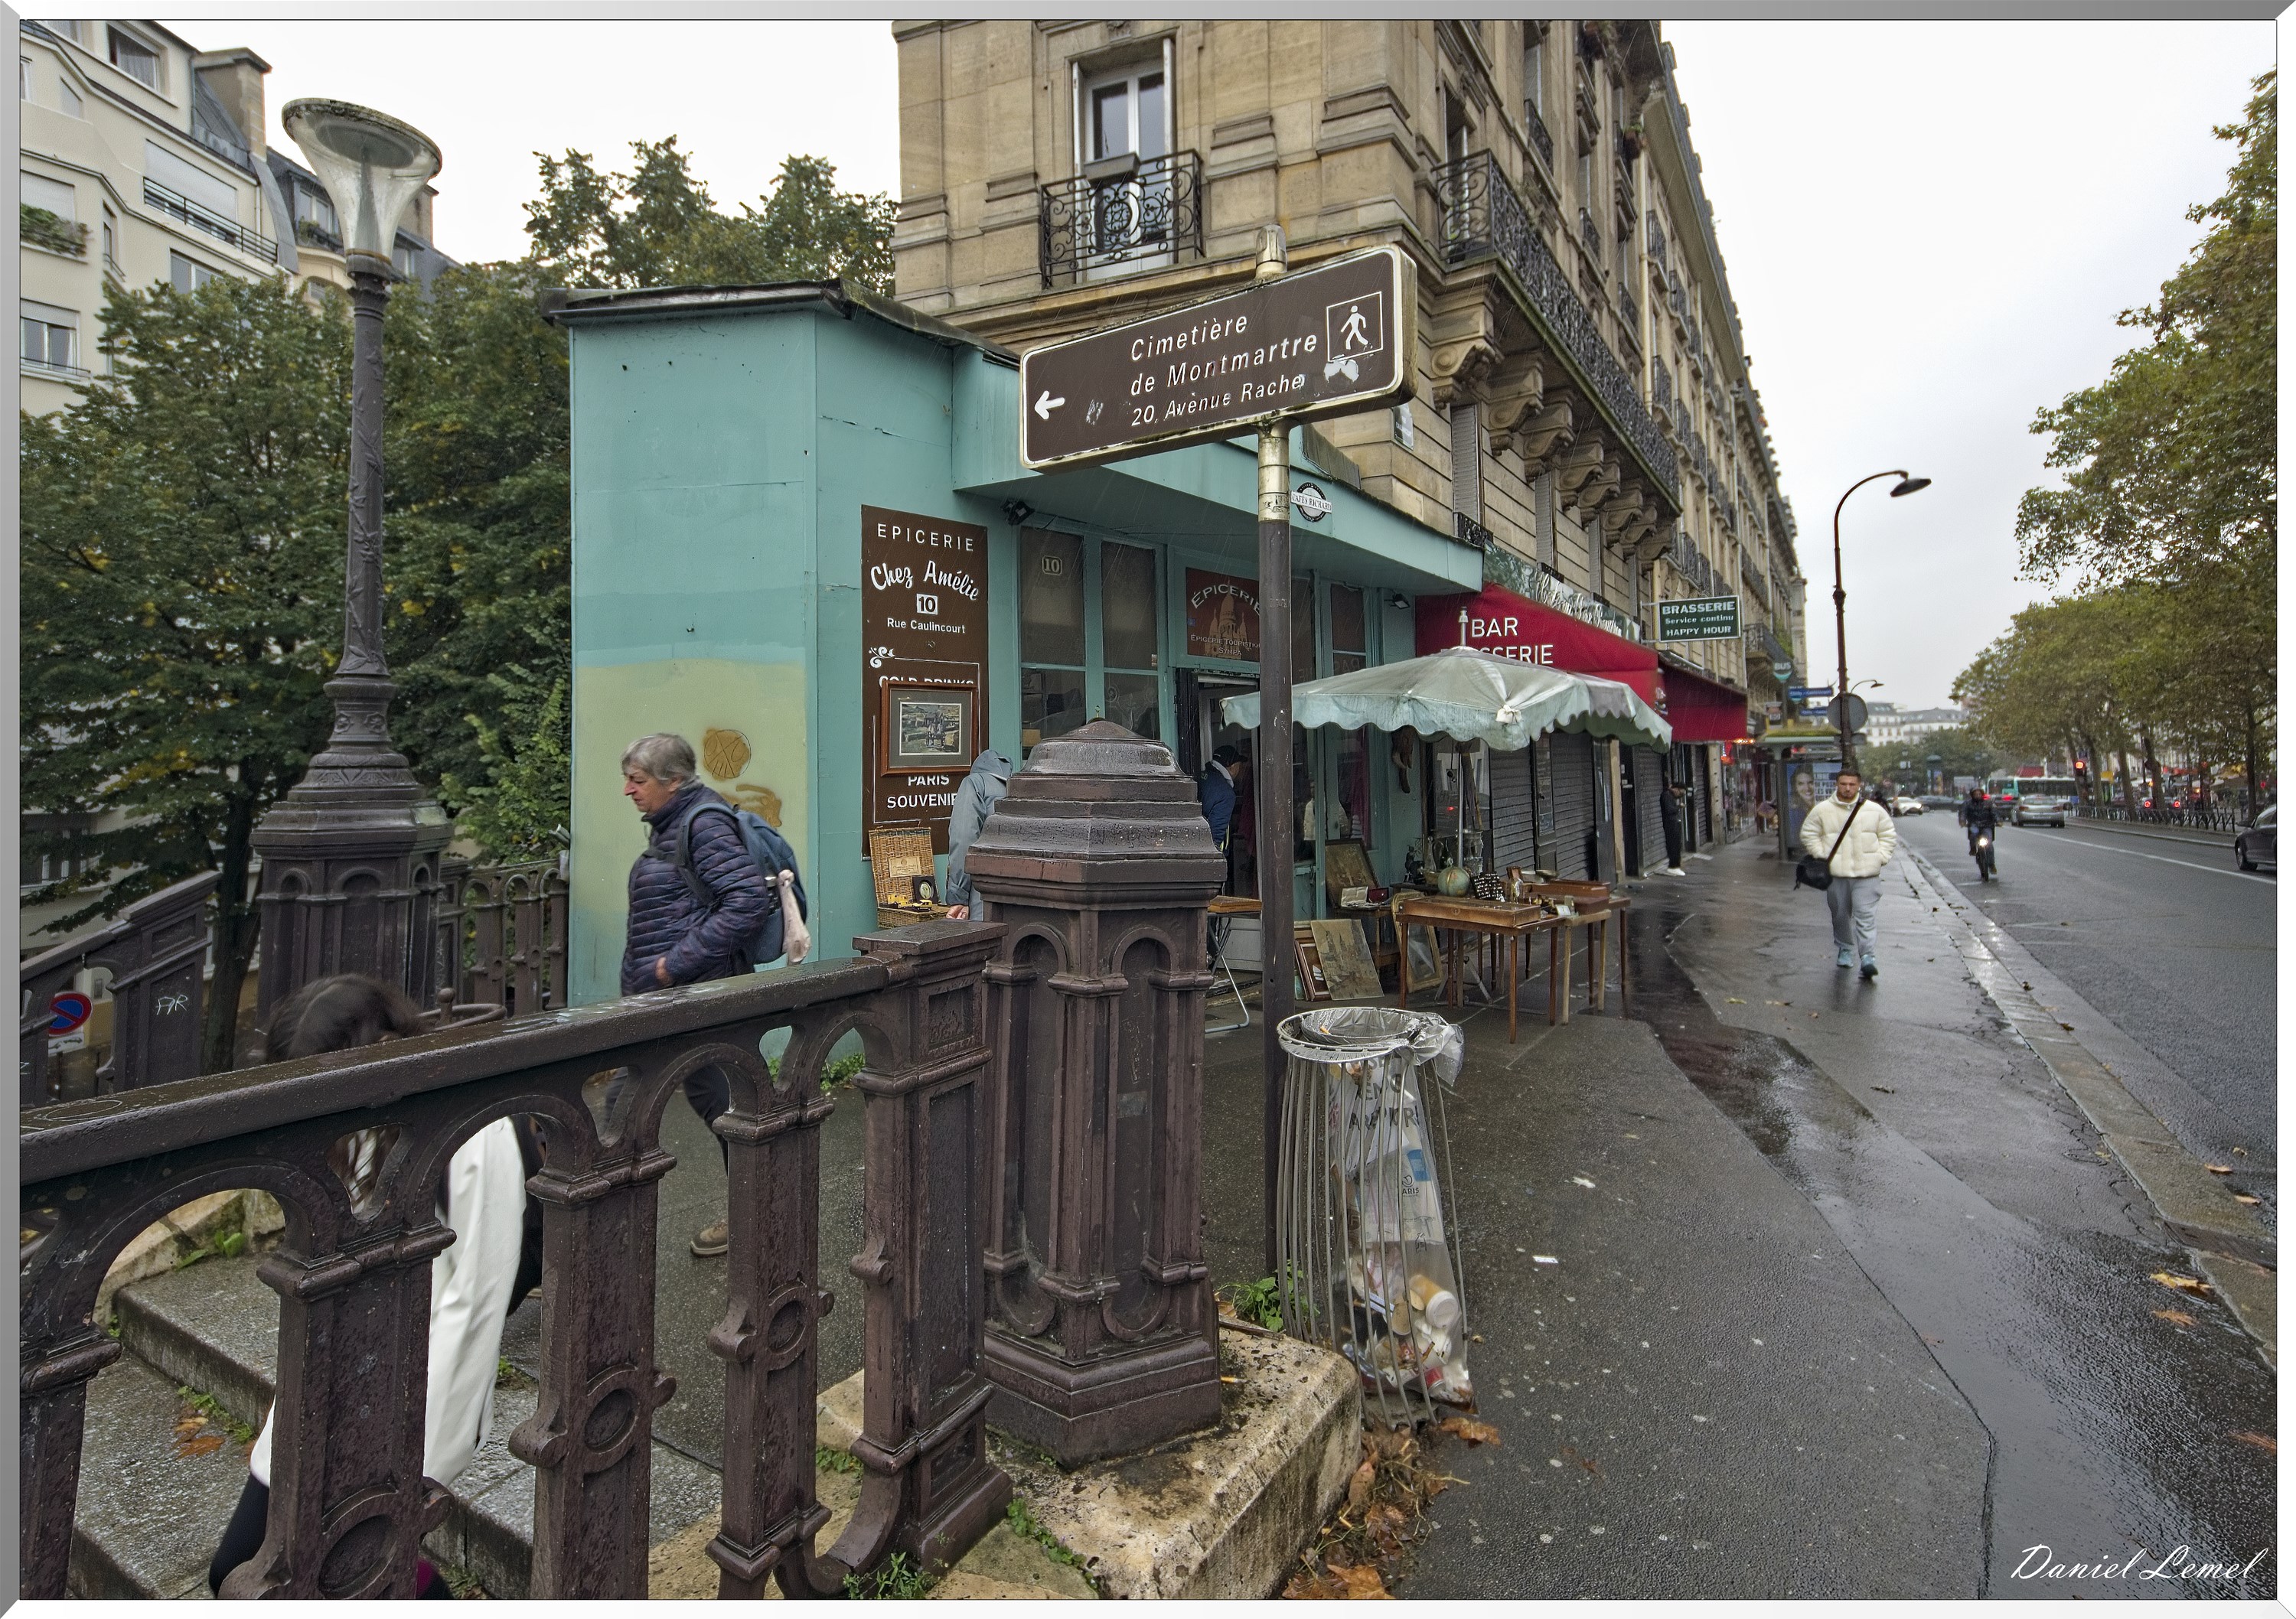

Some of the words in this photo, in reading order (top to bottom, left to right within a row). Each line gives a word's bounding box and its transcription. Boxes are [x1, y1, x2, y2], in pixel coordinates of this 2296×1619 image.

[1130, 315, 1247, 361] Cimetière
[1130, 373, 1155, 396] de
[1167, 334, 1318, 387] Montmartre
[1131, 405, 1159, 426] 20,
[1163, 393, 1231, 422] Avenue
[1241, 374, 1305, 402] Rache
[877, 523, 974, 552] EPICERIE
[1044, 559, 1060, 573] 10
[870, 562, 914, 590] Chez
[923, 560, 979, 601] Amélie
[918, 597, 936, 613] 10
[1662, 601, 1735, 615] BRASSERIE
[887, 617, 907, 629] Rue
[910, 620, 966, 634] Caulincourt
[1471, 617, 1518, 637] BAR
[1666, 627, 1699, 637] HAPPY
[1704, 625, 1731, 634] HOUR
[1774, 661, 1792, 671] BUS
[908, 774, 950, 787] PARIS
